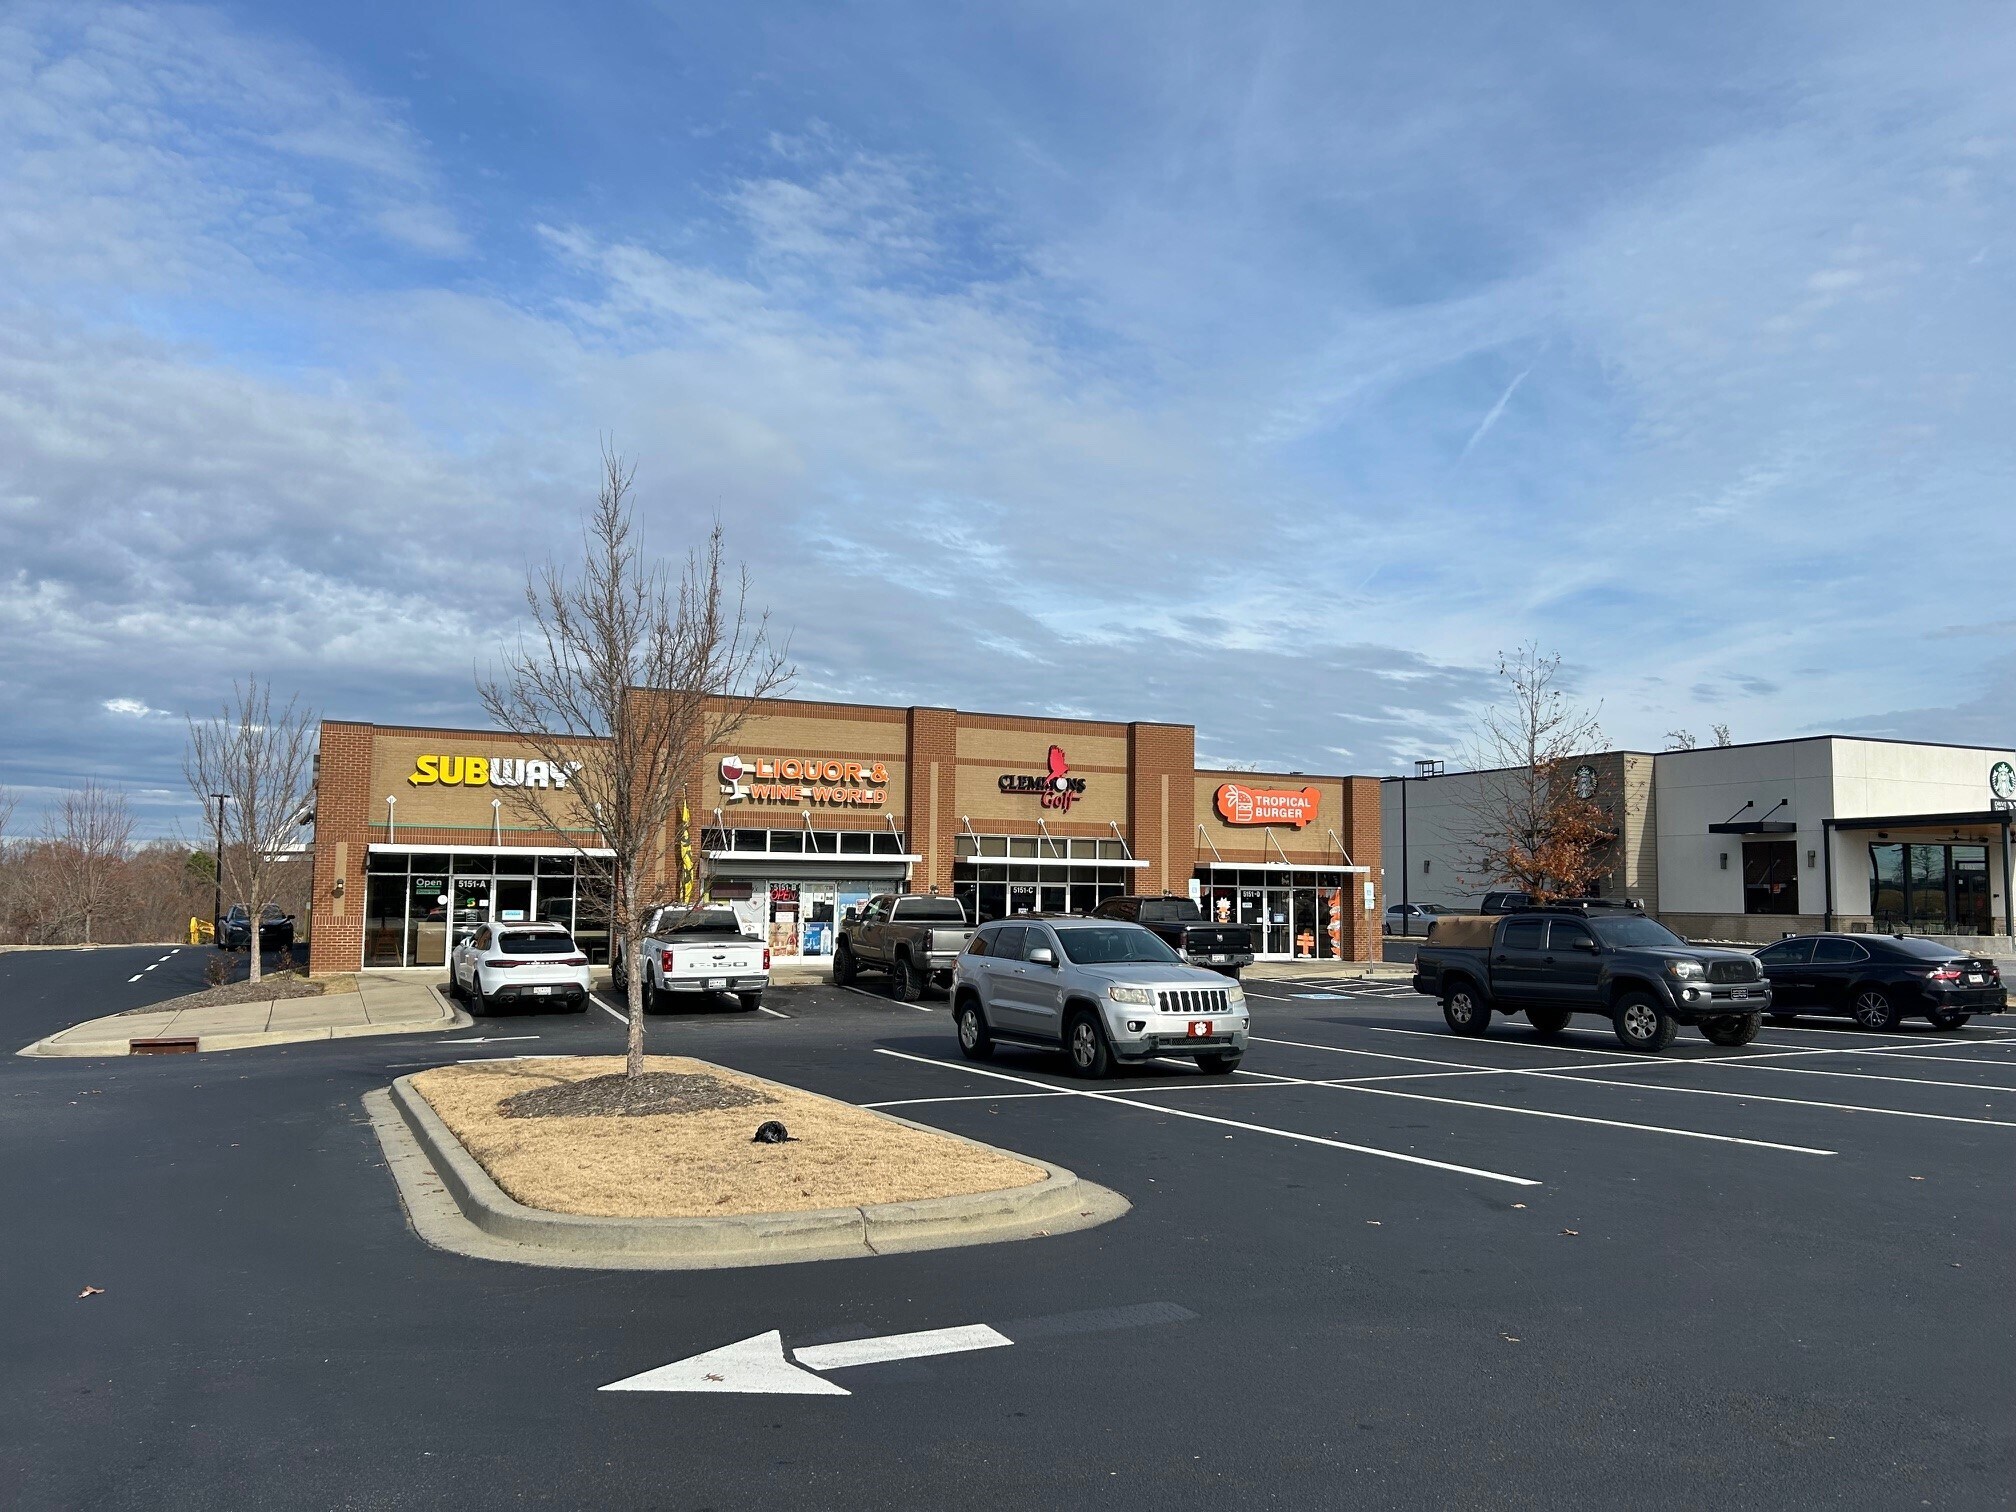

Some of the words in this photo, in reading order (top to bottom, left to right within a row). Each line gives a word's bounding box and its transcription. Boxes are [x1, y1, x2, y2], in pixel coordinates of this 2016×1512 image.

[408, 755, 582, 789] SUBWAY
[756, 758, 863, 782] LIQUOR
[870, 762, 890, 783] &
[750, 784, 804, 801] WINE
[812, 787, 888, 804] WORLD
[1040, 790, 1083, 814] Golf
[1255, 796, 1311, 807] TROPICAL
[1255, 807, 1303, 818] BURGER
[416, 877, 442, 888] Open
[770, 889, 798, 901] OPEN
